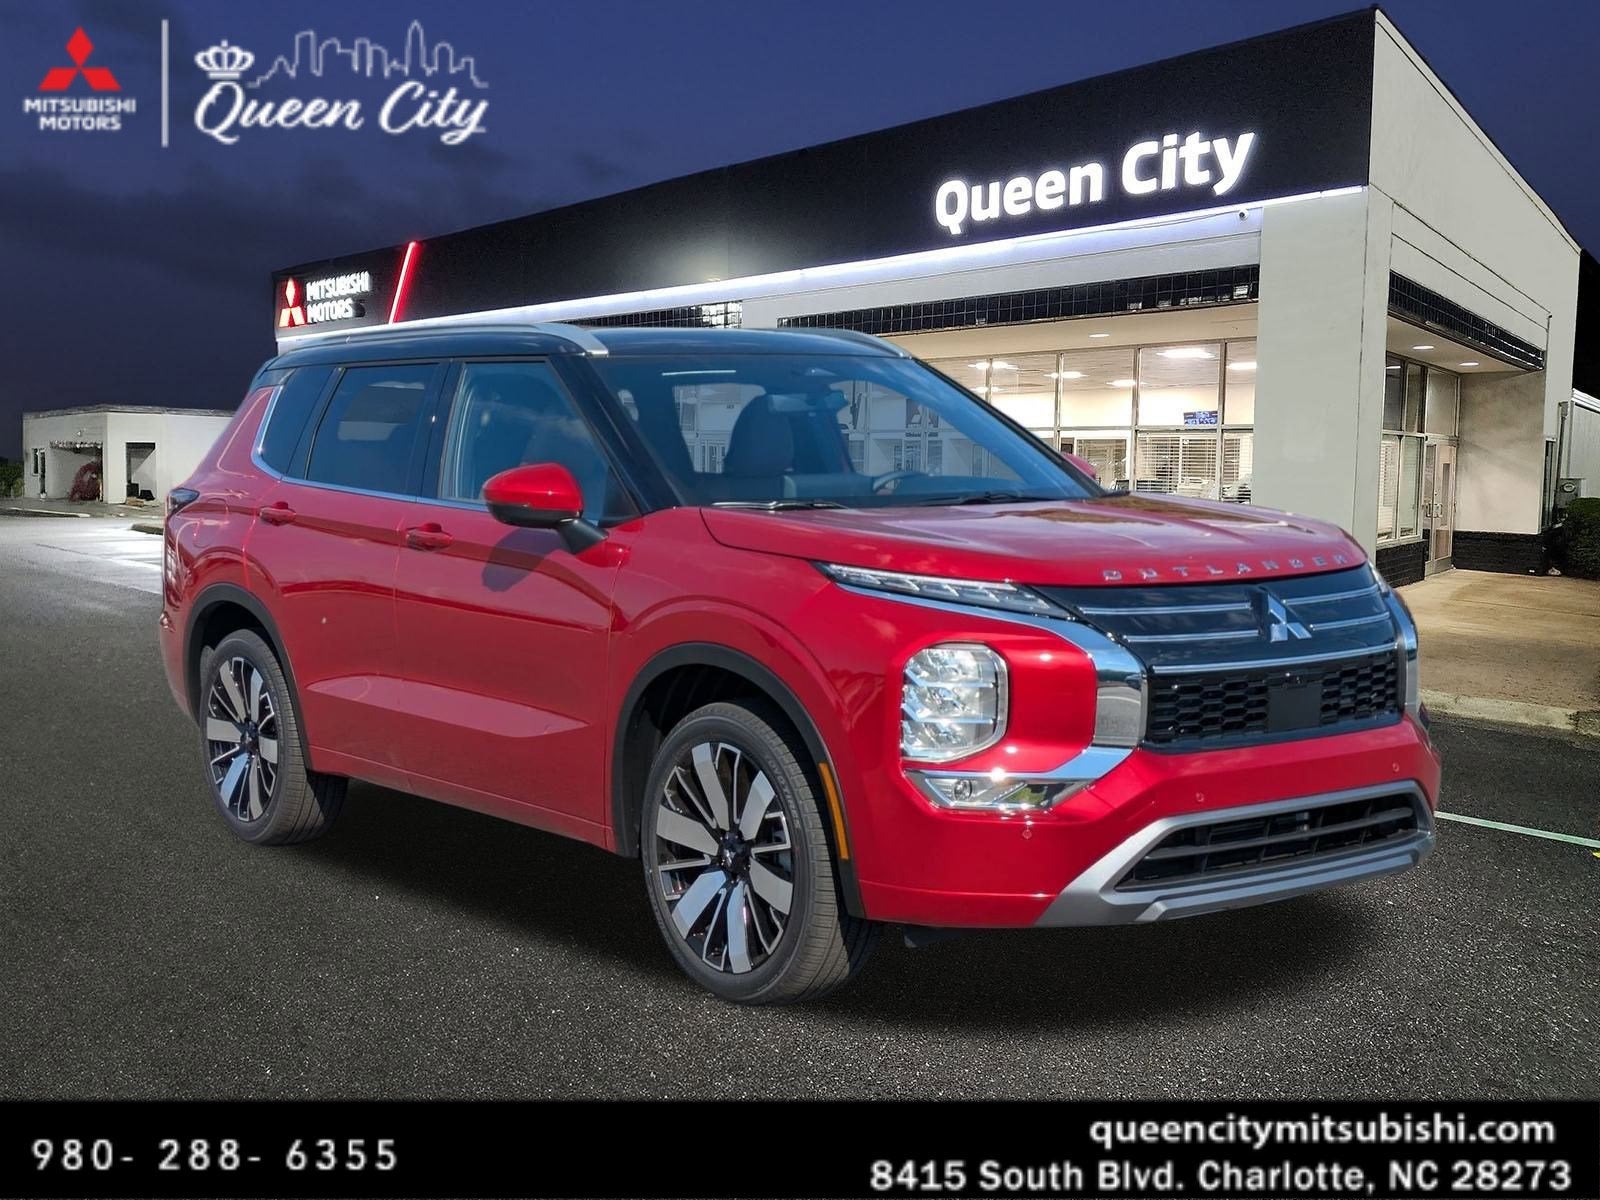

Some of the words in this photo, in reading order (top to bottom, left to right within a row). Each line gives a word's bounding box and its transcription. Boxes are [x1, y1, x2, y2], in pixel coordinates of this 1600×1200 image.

[935, 161, 1104, 235] Queen
[1121, 131, 1255, 196] City
[305, 270, 371, 302] MITSUBISHI
[306, 298, 355, 324] MOTORS
[1102, 553, 1349, 581] OUTLANDER
